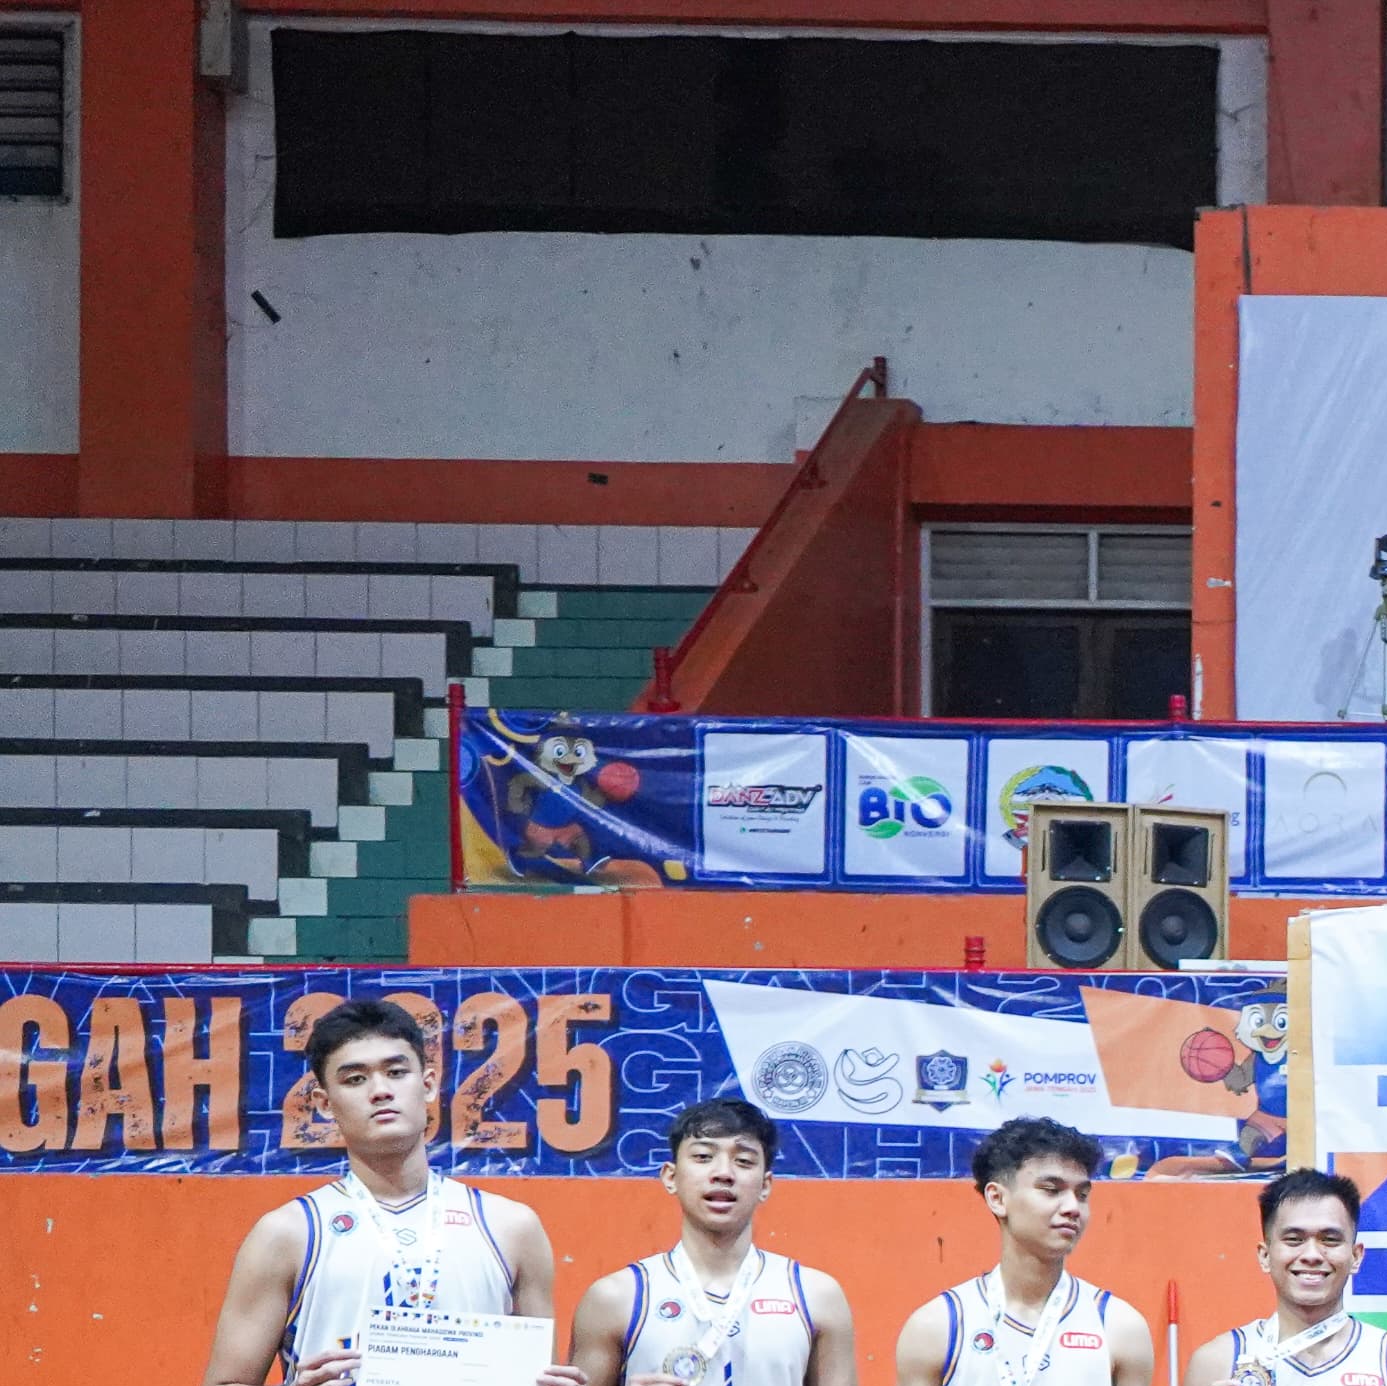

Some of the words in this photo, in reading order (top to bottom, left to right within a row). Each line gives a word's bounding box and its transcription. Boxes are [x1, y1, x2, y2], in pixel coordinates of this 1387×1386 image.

[858, 787, 953, 829] BIO
[0, 994, 243, 1153] GAH
[280, 992, 613, 1153] 225
[1023, 1072, 1097, 1085] POMPROV
[754, 1300, 793, 1314] LIMA
[1063, 1334, 1099, 1348] LIMA
[368, 1344, 399, 1355] PIAGAM
[401, 1347, 459, 1359] PENGHARGAAN
